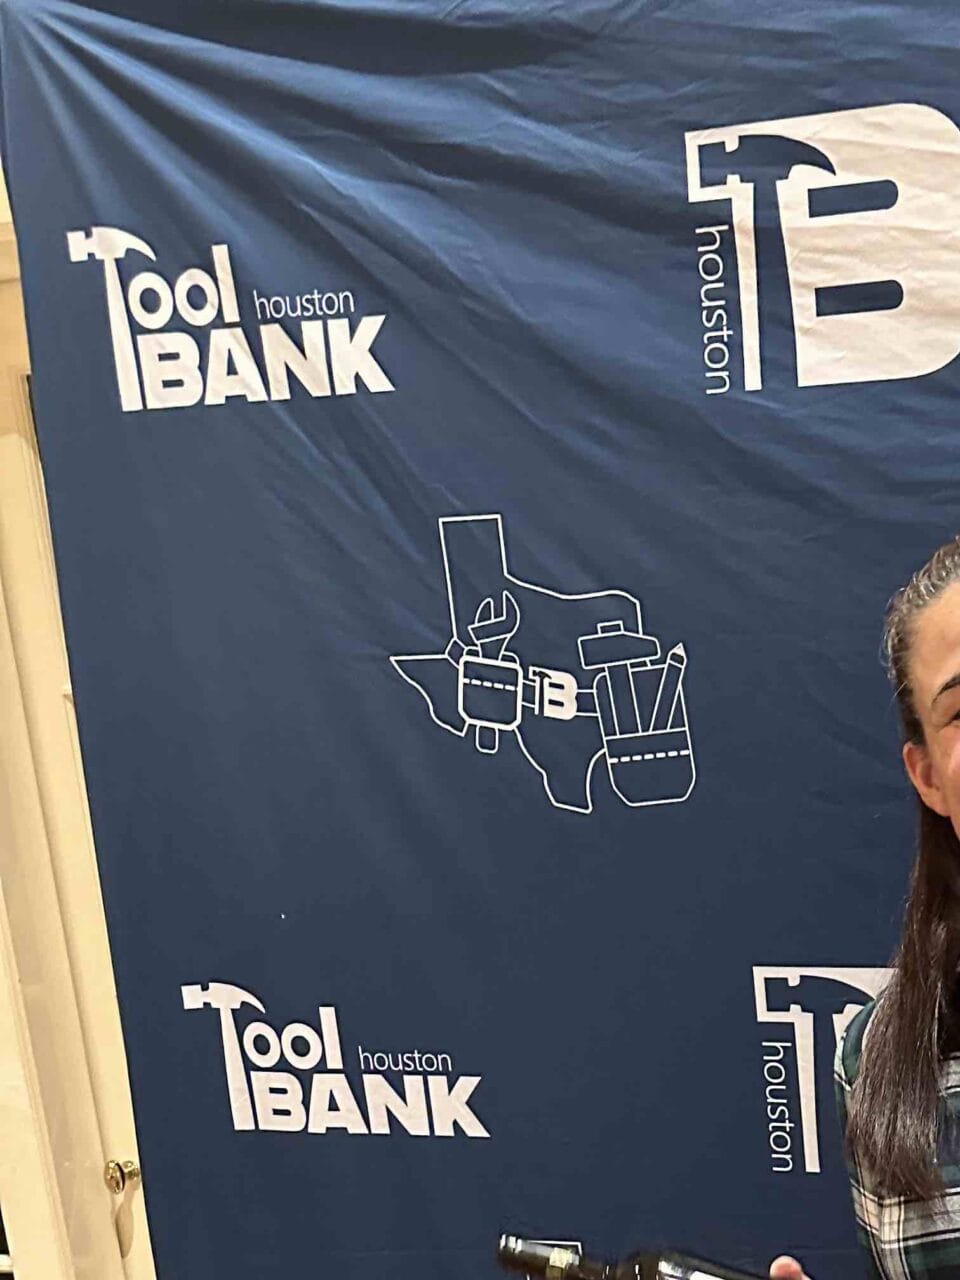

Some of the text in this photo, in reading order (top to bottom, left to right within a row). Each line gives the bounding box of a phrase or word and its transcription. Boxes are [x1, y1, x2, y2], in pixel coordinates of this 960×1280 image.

[67, 226, 241, 412] Tool
[253, 288, 356, 320] houston
[695, 224, 734, 396] houston
[136, 313, 396, 410] BANK
[181, 981, 344, 1131] Tool
[250, 1070, 492, 1138] BANK
[358, 1045, 452, 1072] houston
[761, 1041, 795, 1172] houston
